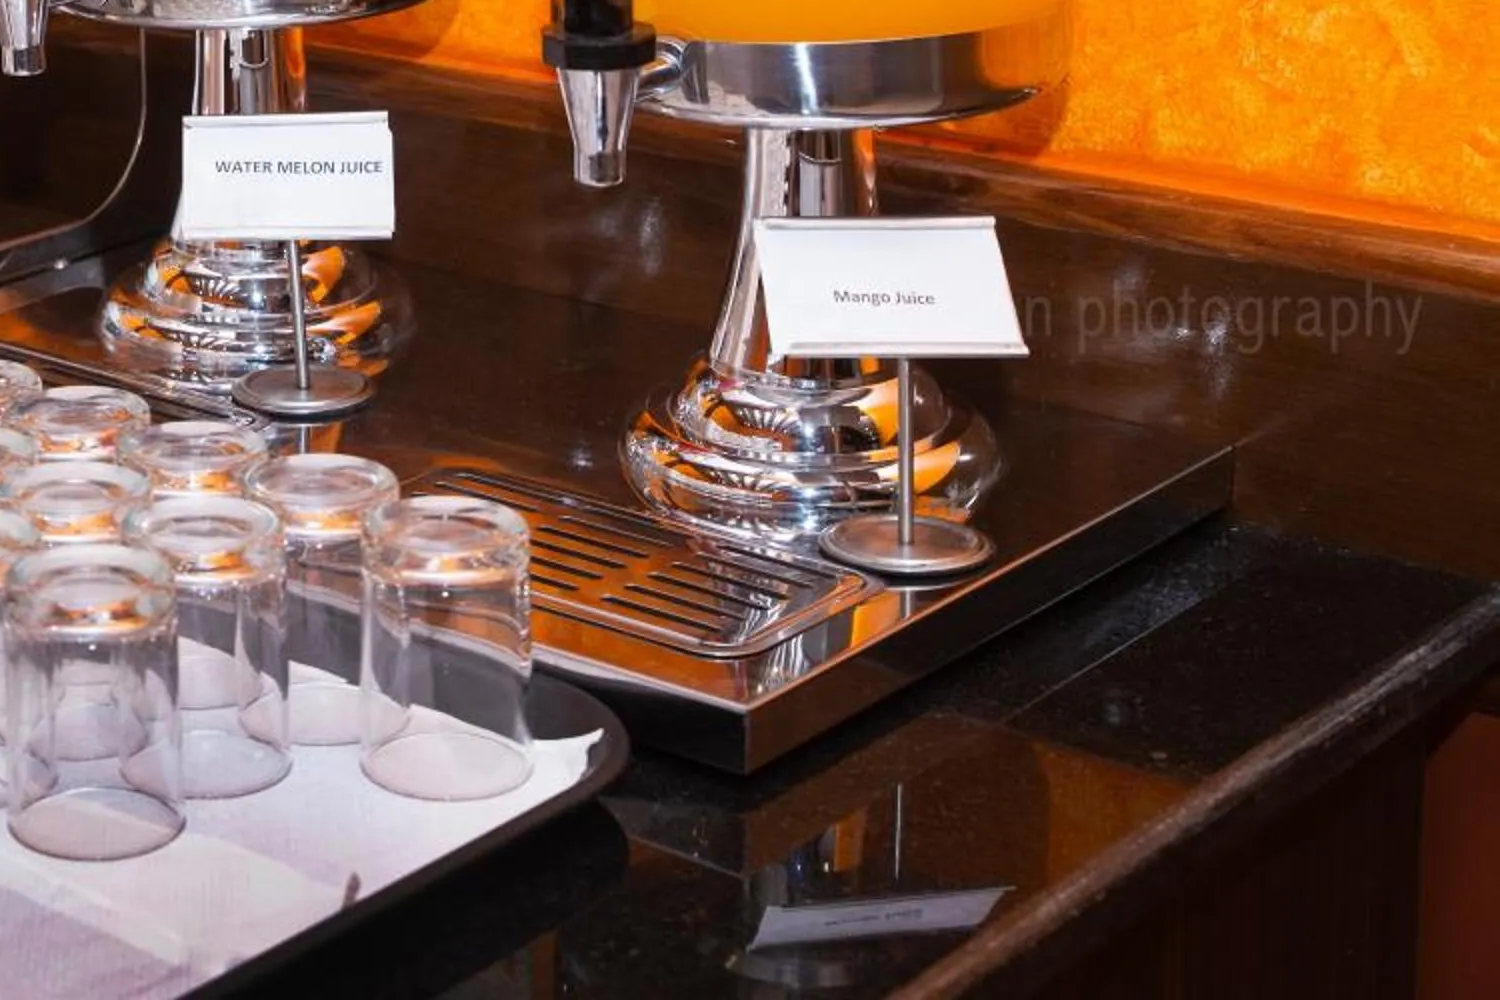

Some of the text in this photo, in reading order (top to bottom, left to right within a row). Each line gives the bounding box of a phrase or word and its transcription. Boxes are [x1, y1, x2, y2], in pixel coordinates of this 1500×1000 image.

[215, 160, 384, 175] WATER MELON JUICE
[833, 289, 936, 306] Mango Juice
